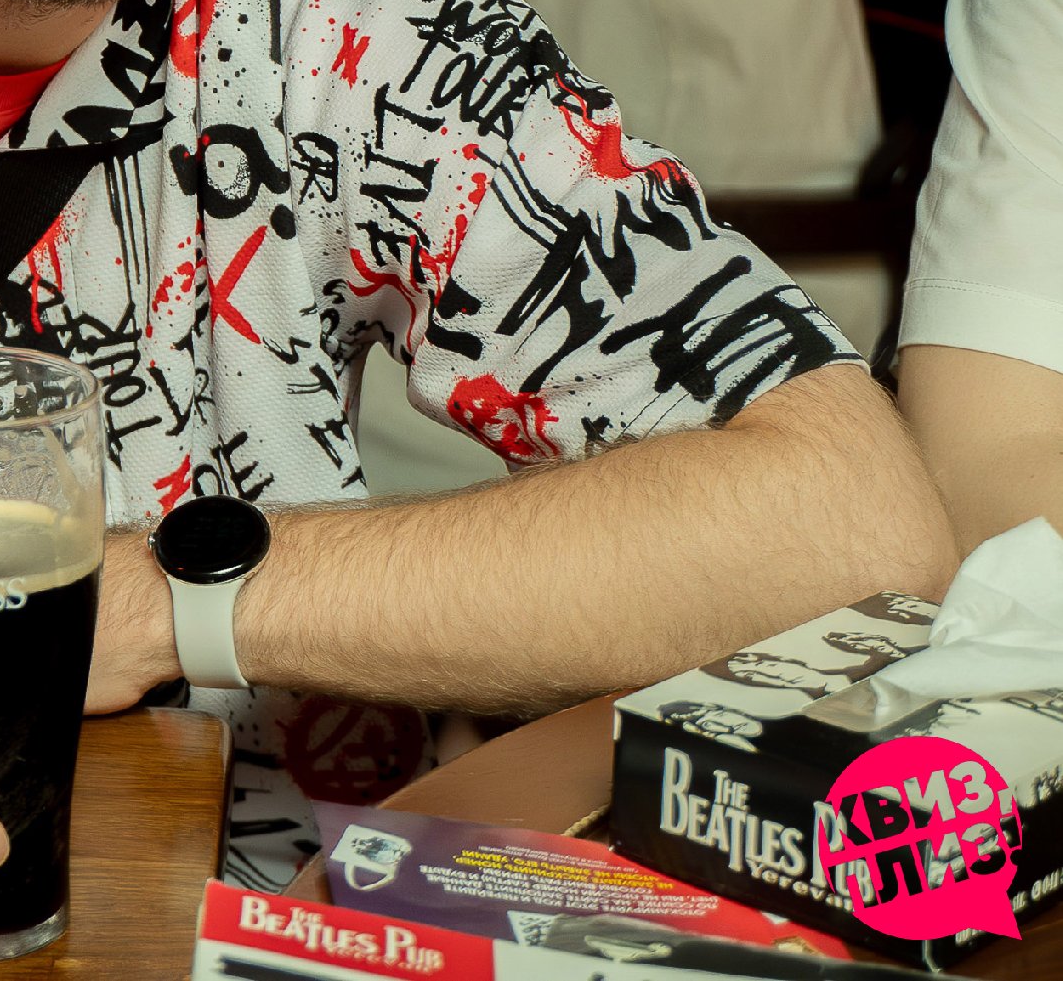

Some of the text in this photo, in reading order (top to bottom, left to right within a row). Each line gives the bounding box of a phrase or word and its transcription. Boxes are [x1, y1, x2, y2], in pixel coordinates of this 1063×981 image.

[660, 747, 808, 878] BEATLES
[713, 770, 751, 806] THE
[239, 895, 378, 956] BEATLES
[385, 925, 444, 971] PUB
[290, 907, 324, 925] THE
